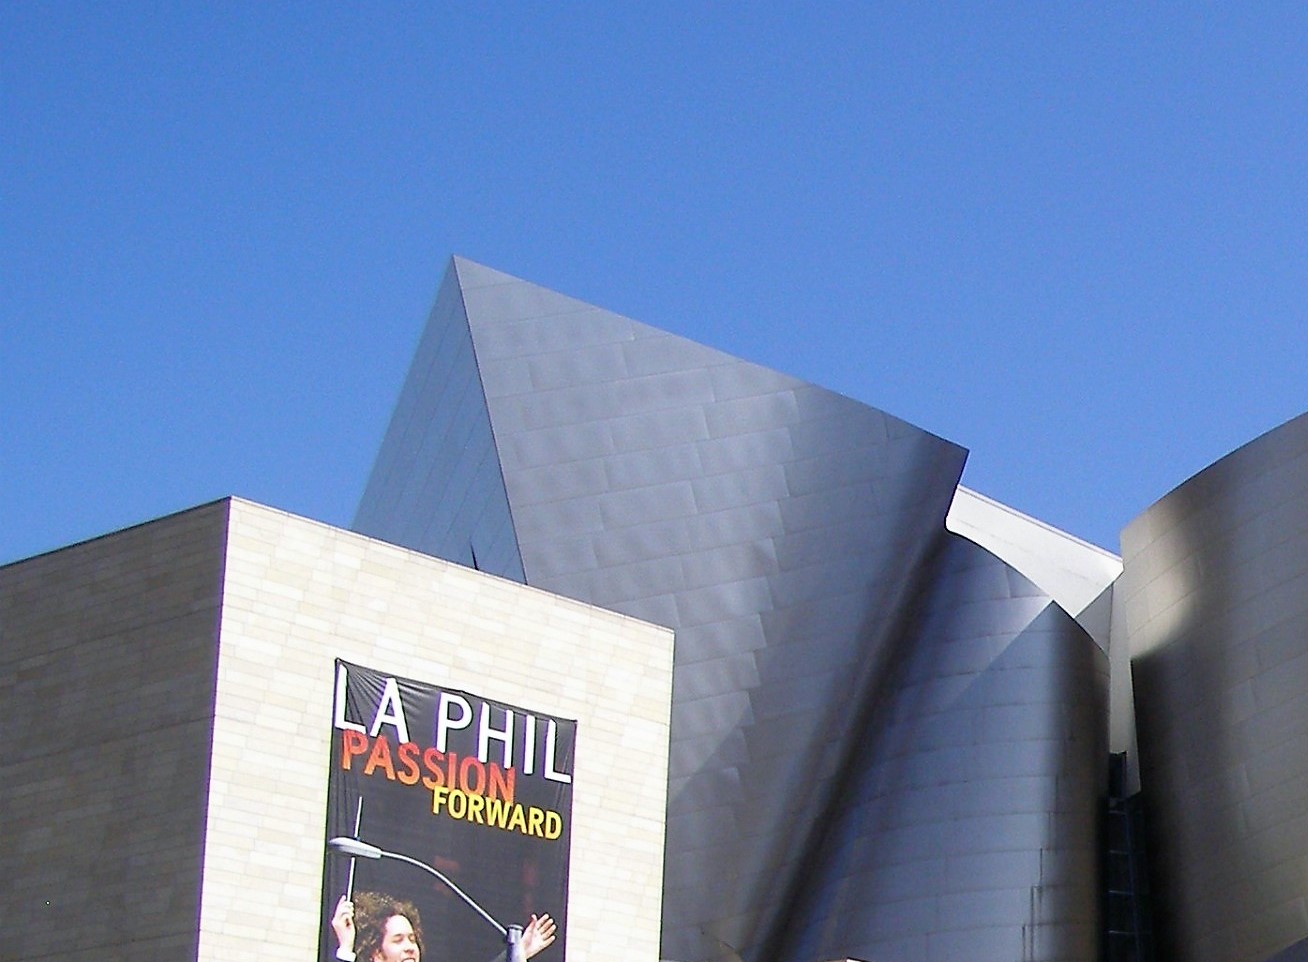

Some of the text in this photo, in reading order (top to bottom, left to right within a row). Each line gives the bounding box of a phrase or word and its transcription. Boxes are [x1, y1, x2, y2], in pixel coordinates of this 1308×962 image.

[334, 664, 572, 784] LA PHIL
[341, 729, 517, 804] PASSION
[432, 786, 563, 841] FORWARD
